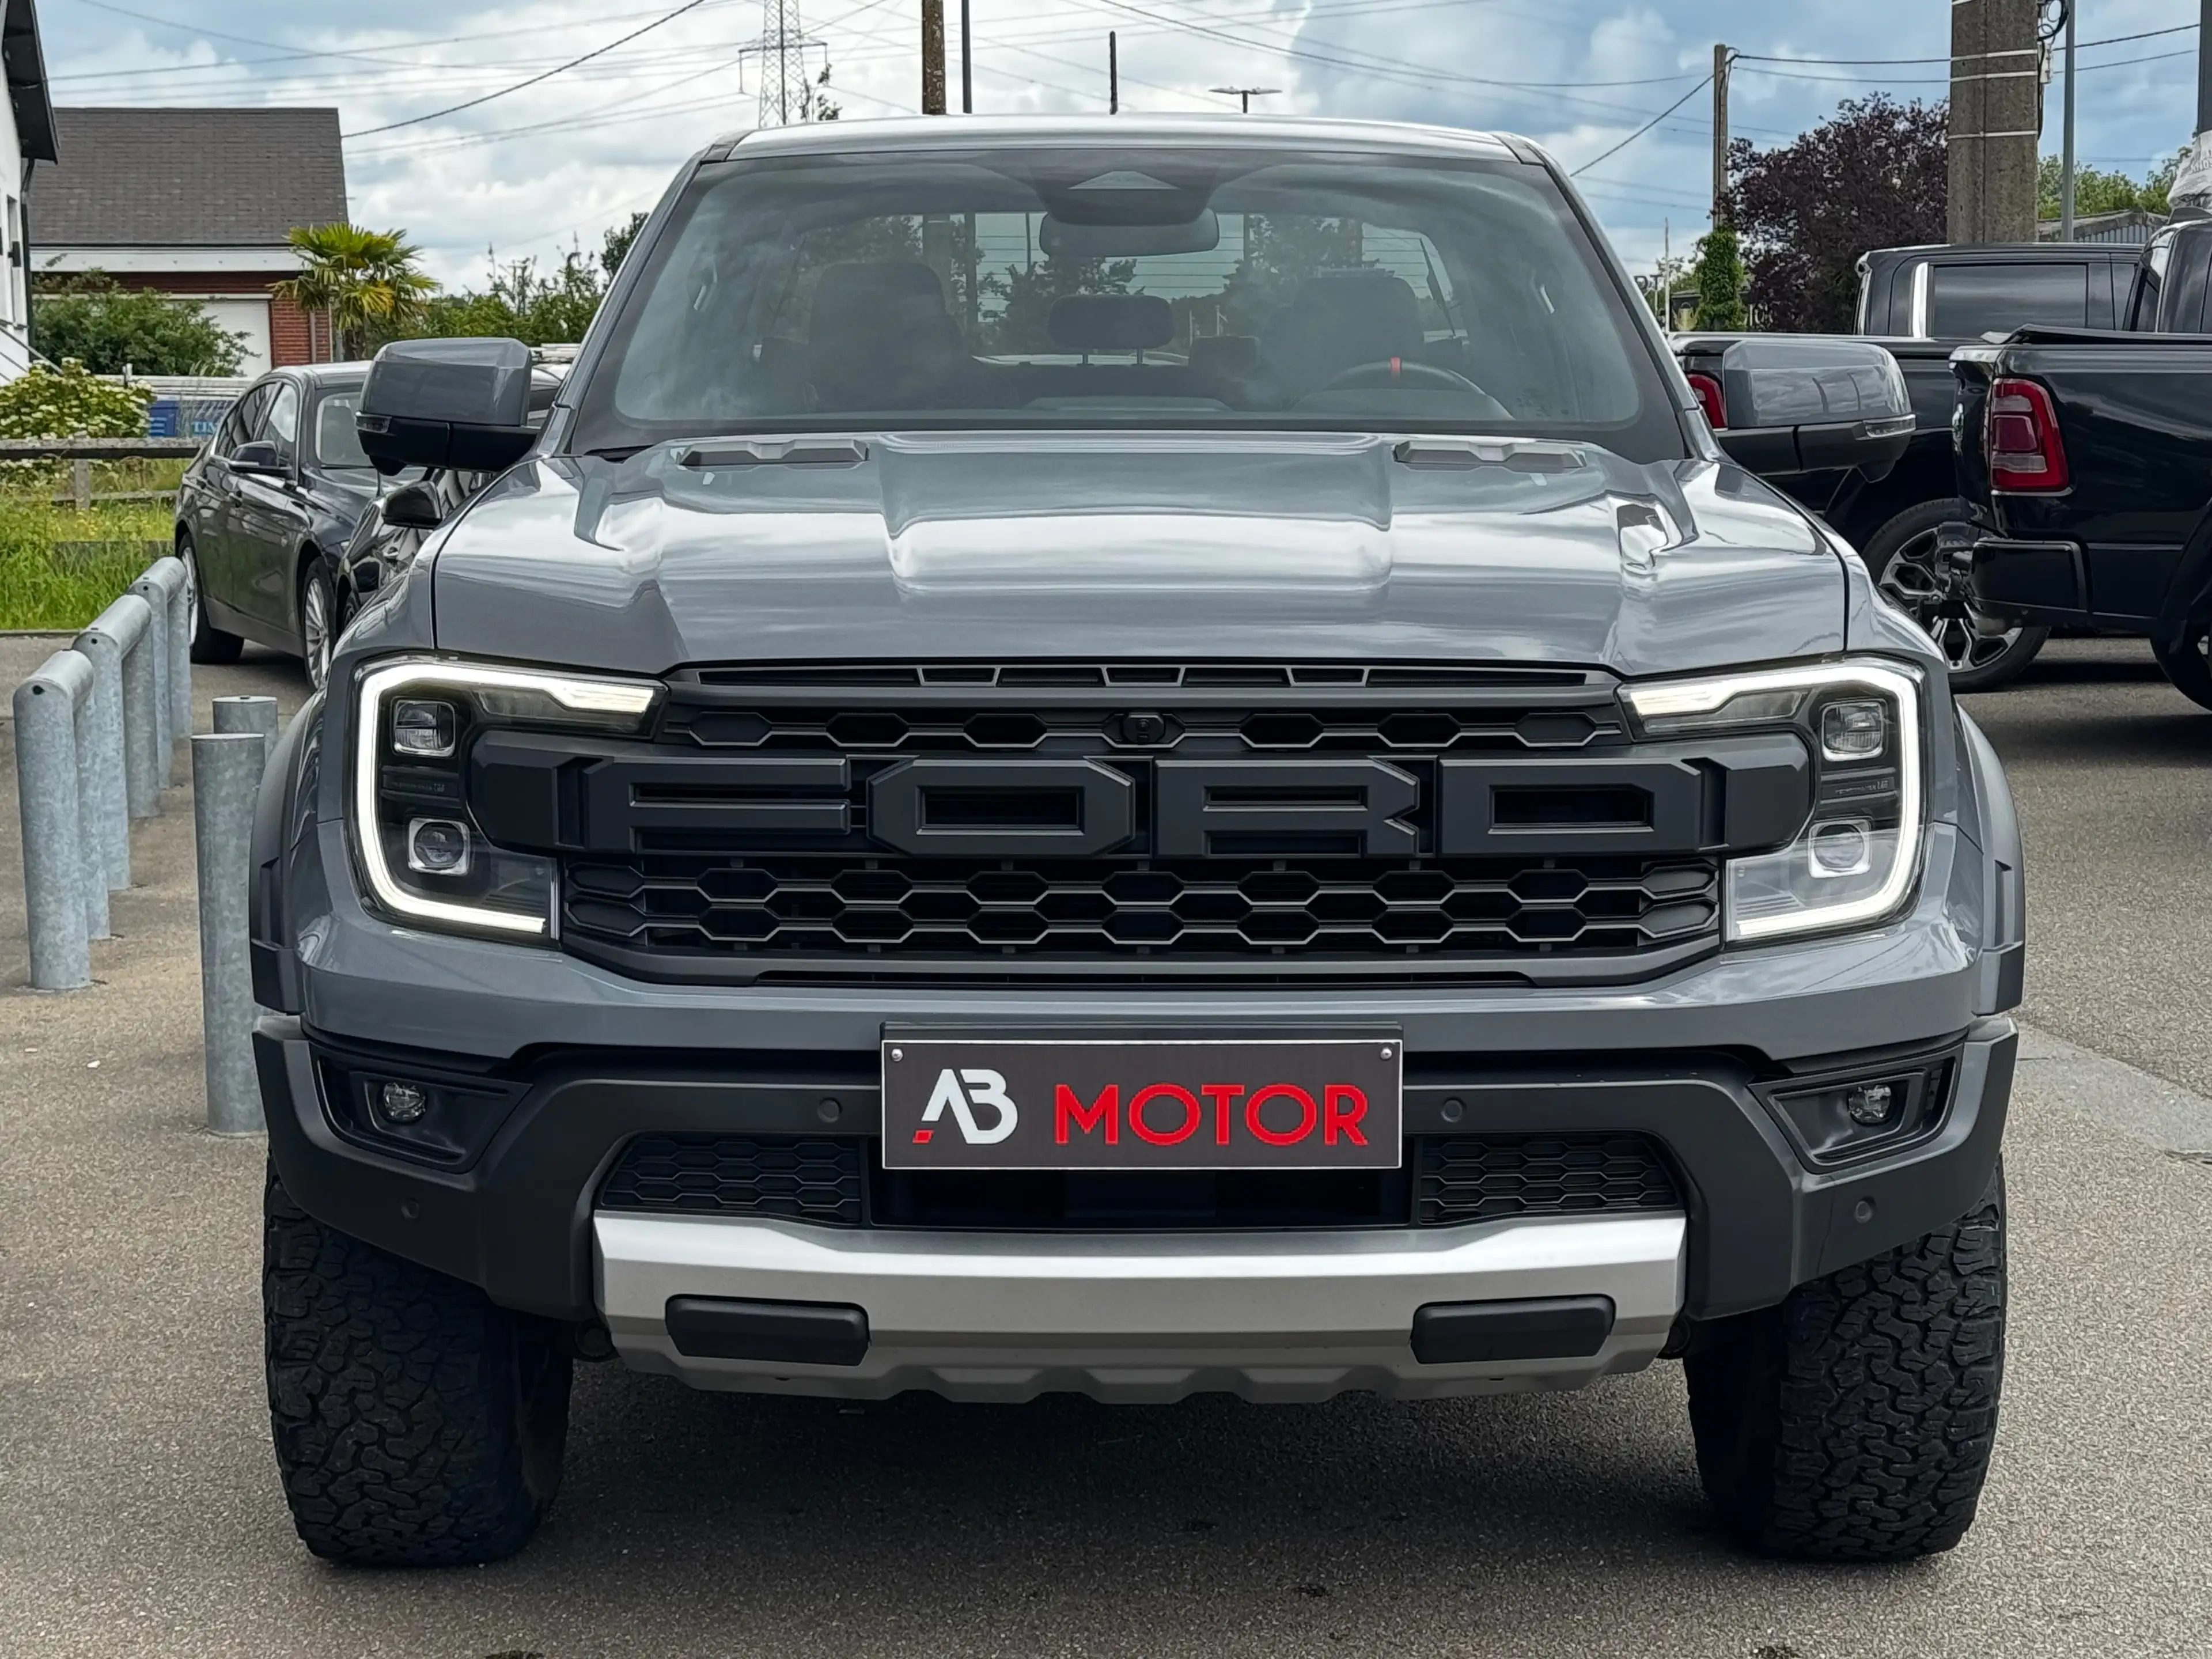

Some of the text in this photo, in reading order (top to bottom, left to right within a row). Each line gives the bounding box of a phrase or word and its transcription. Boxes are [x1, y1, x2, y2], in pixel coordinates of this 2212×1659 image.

[582, 755, 1701, 857] FORD
[912, 1069, 1369, 1146] AB MOTOR
